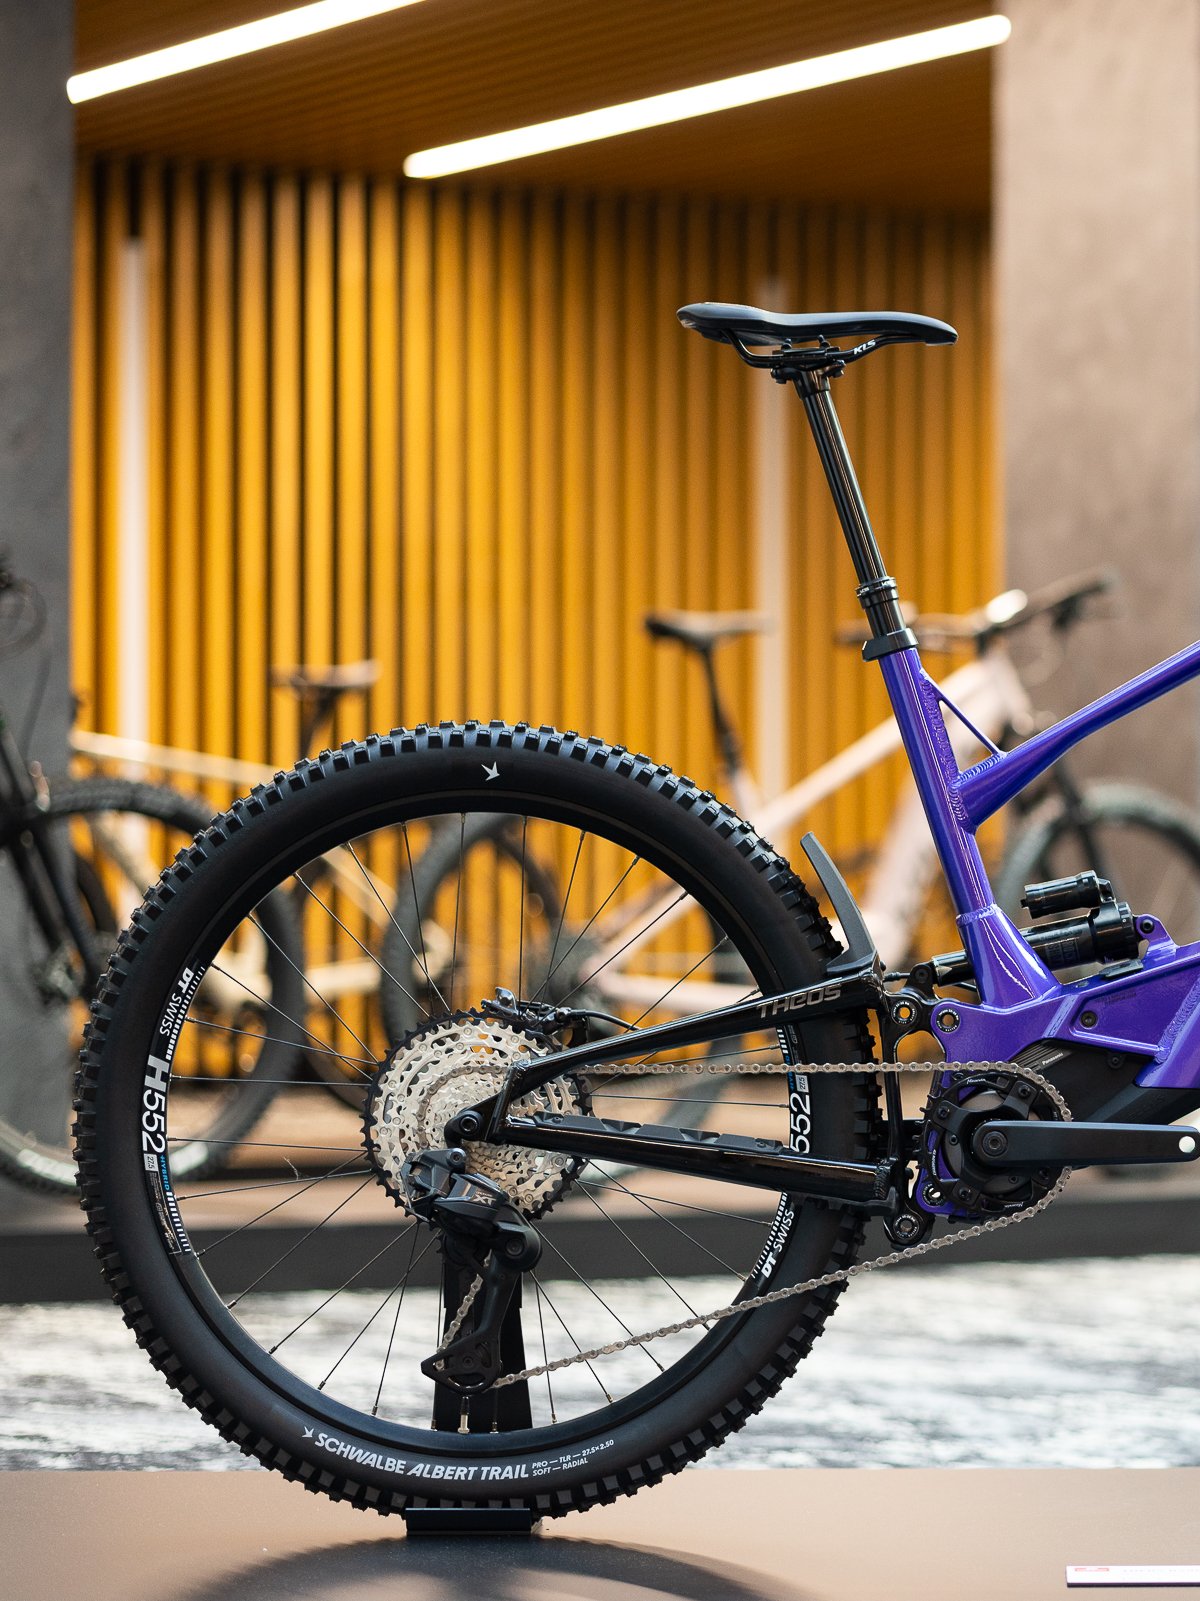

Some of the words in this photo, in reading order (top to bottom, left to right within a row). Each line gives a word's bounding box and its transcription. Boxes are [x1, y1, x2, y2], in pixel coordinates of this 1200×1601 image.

[853, 339, 876, 355] KLS
[177, 966, 195, 994] DT
[160, 993, 182, 1037] SWISS
[142, 1054, 170, 1154] H552
[790, 1092, 811, 1154] 552
[761, 1251, 777, 1278] DT
[773, 1209, 795, 1253] SWISS
[315, 1432, 407, 1475] SCHWALBE
[407, 1462, 475, 1480] ALBERT
[480, 1463, 529, 1480] TRAIL
[532, 1460, 548, 1469] PRO
[559, 1454, 571, 1463] TLR
[532, 1466, 551, 1477] SOFT
[562, 1457, 589, 1470] RADIAL
